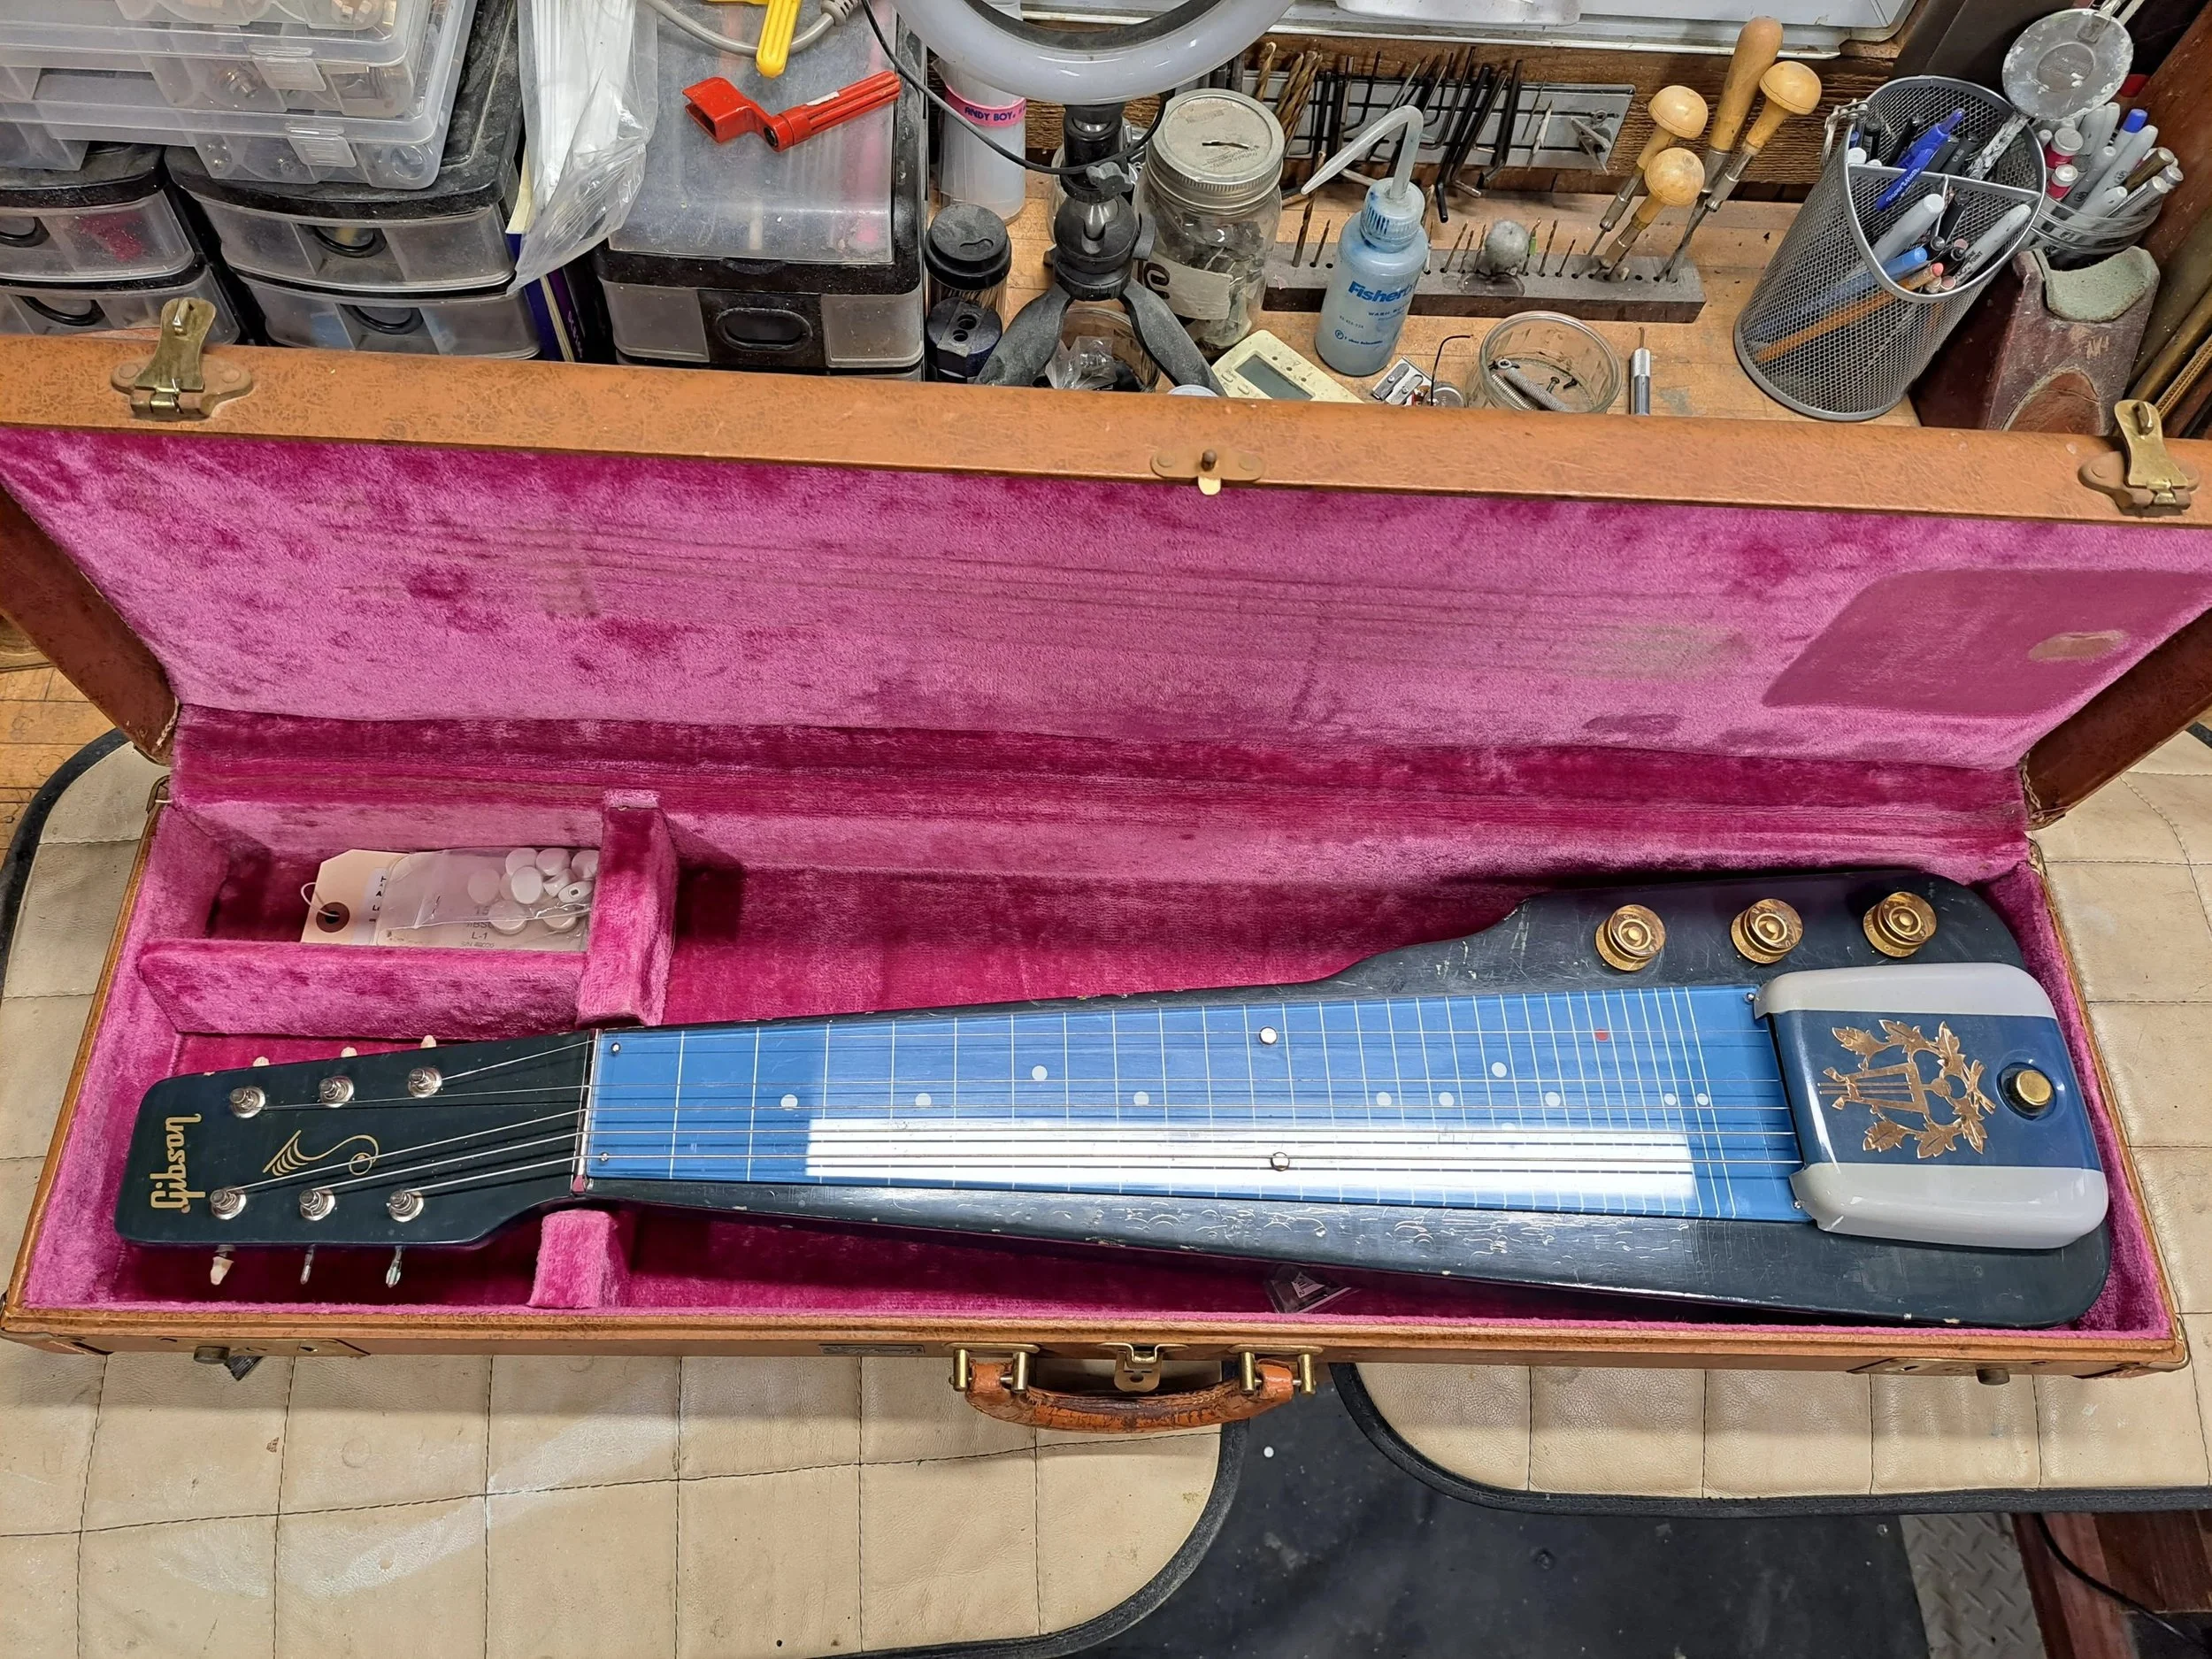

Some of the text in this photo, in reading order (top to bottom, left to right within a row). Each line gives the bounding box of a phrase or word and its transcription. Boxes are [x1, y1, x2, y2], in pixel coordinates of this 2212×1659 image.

[964, 107, 990, 121] ANDY
[472, 931, 488, 940] L-1
[150, 1113, 206, 1213] Gibson
